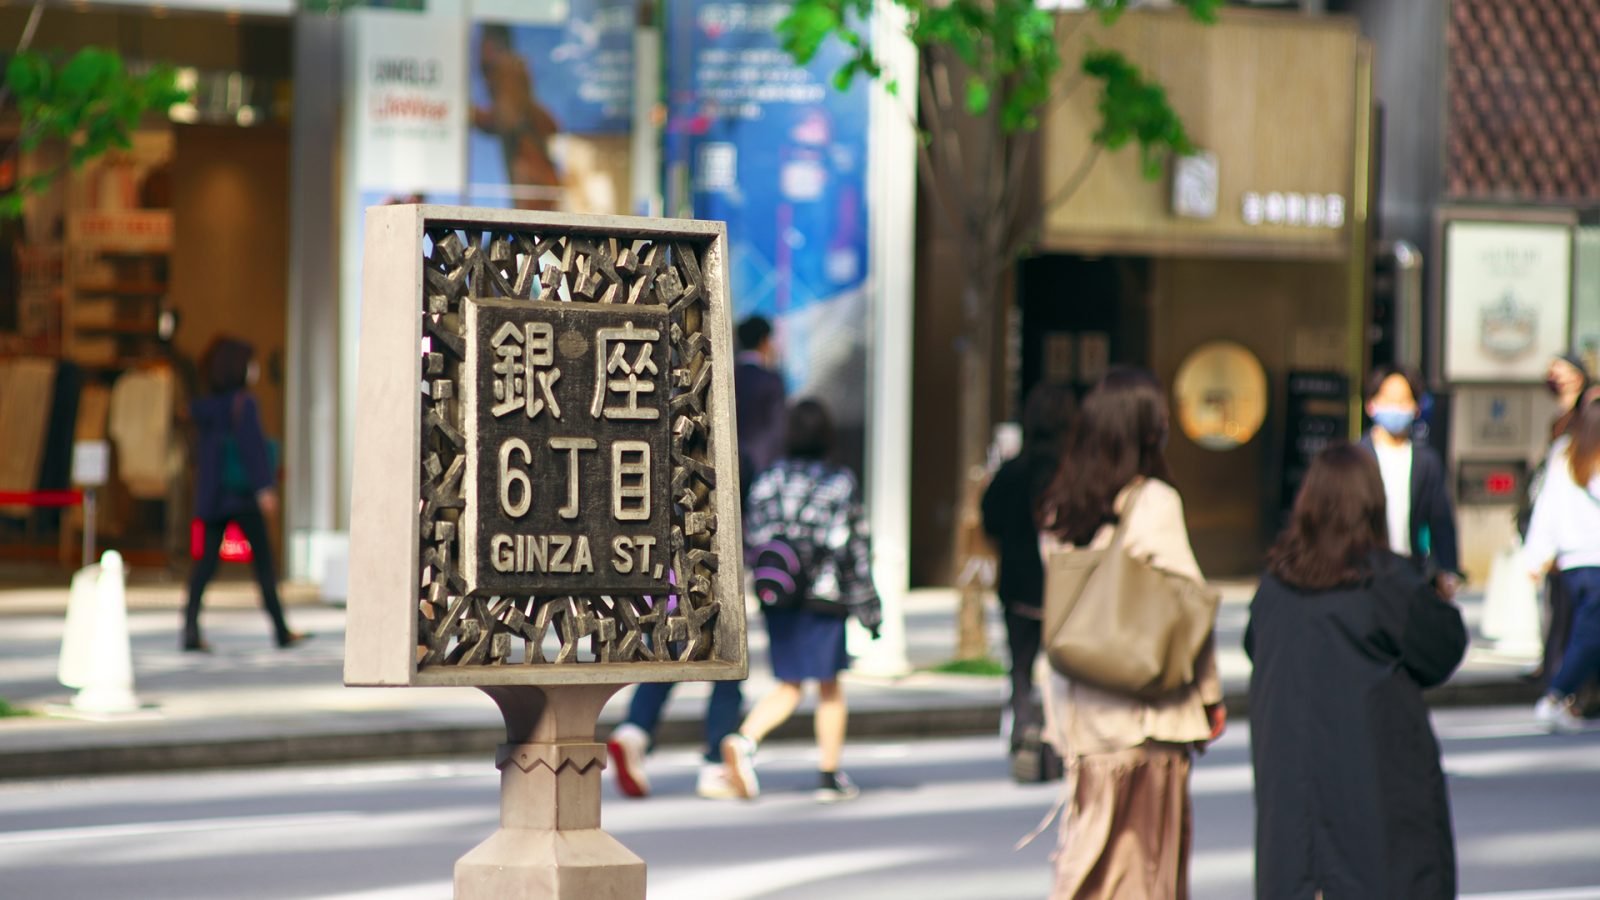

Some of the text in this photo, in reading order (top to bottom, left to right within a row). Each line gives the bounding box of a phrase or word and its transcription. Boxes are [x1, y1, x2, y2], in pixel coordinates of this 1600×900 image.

[490, 321, 660, 420] 銀座
[500, 437, 652, 521] 6丁目
[490, 534, 595, 574] GINZA
